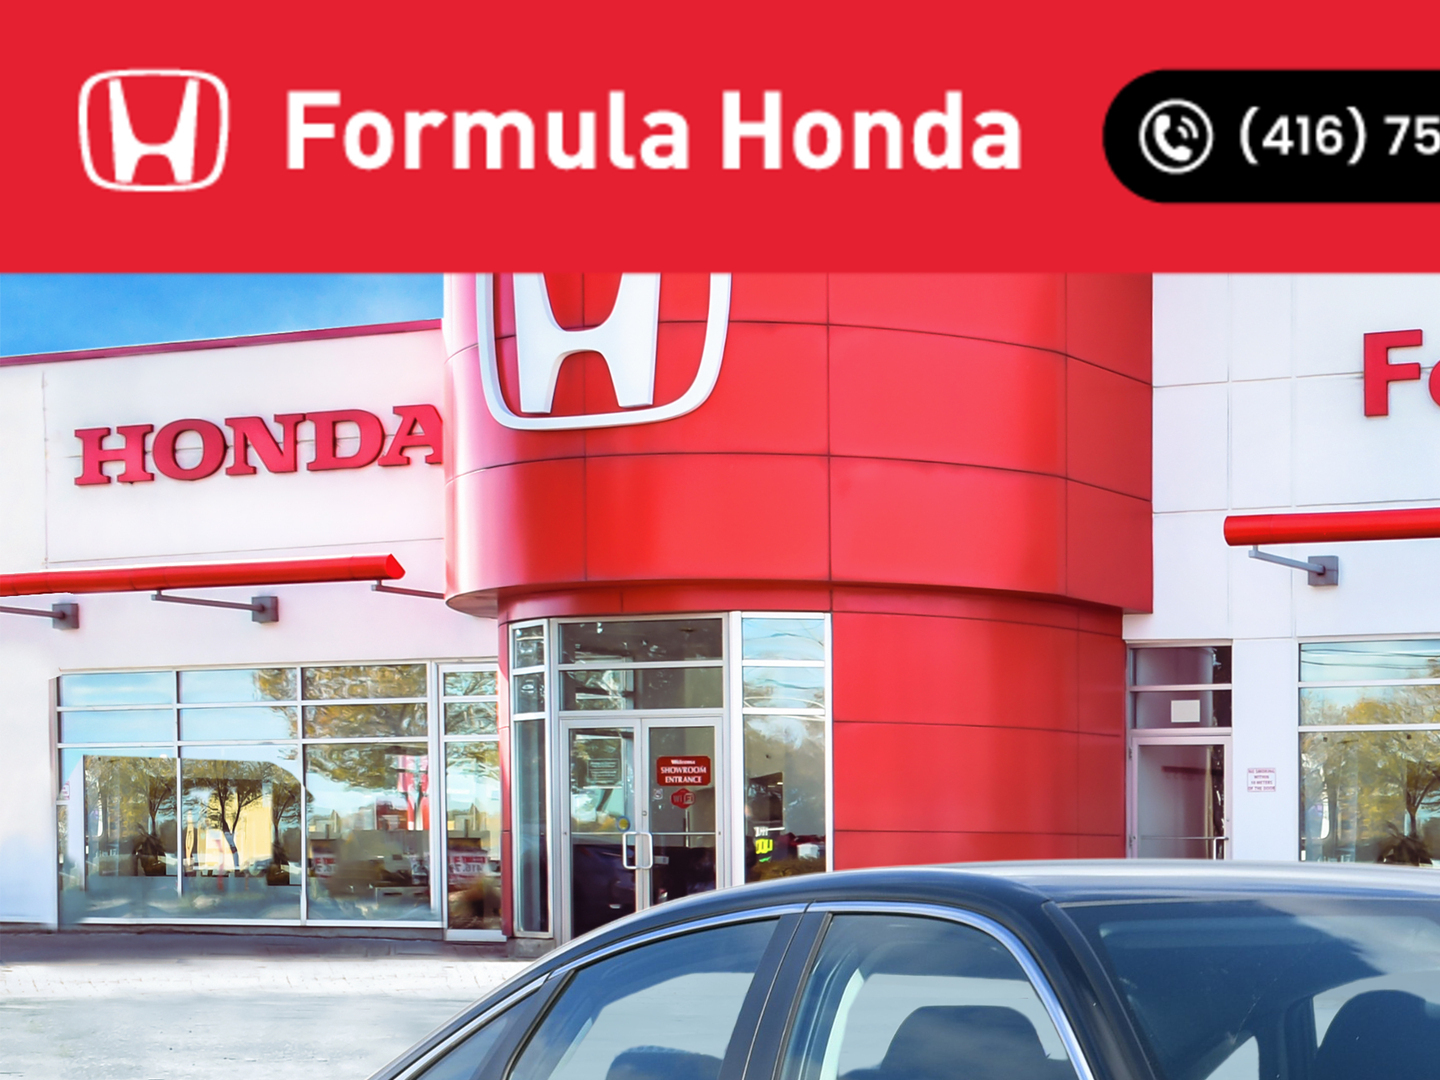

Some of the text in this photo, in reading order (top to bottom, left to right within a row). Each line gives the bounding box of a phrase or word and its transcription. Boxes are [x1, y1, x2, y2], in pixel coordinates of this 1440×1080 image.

[74, 402, 444, 487] HONDA
[660, 766, 707, 774] SHOWROOM
[664, 775, 702, 783] ENTRANCE
